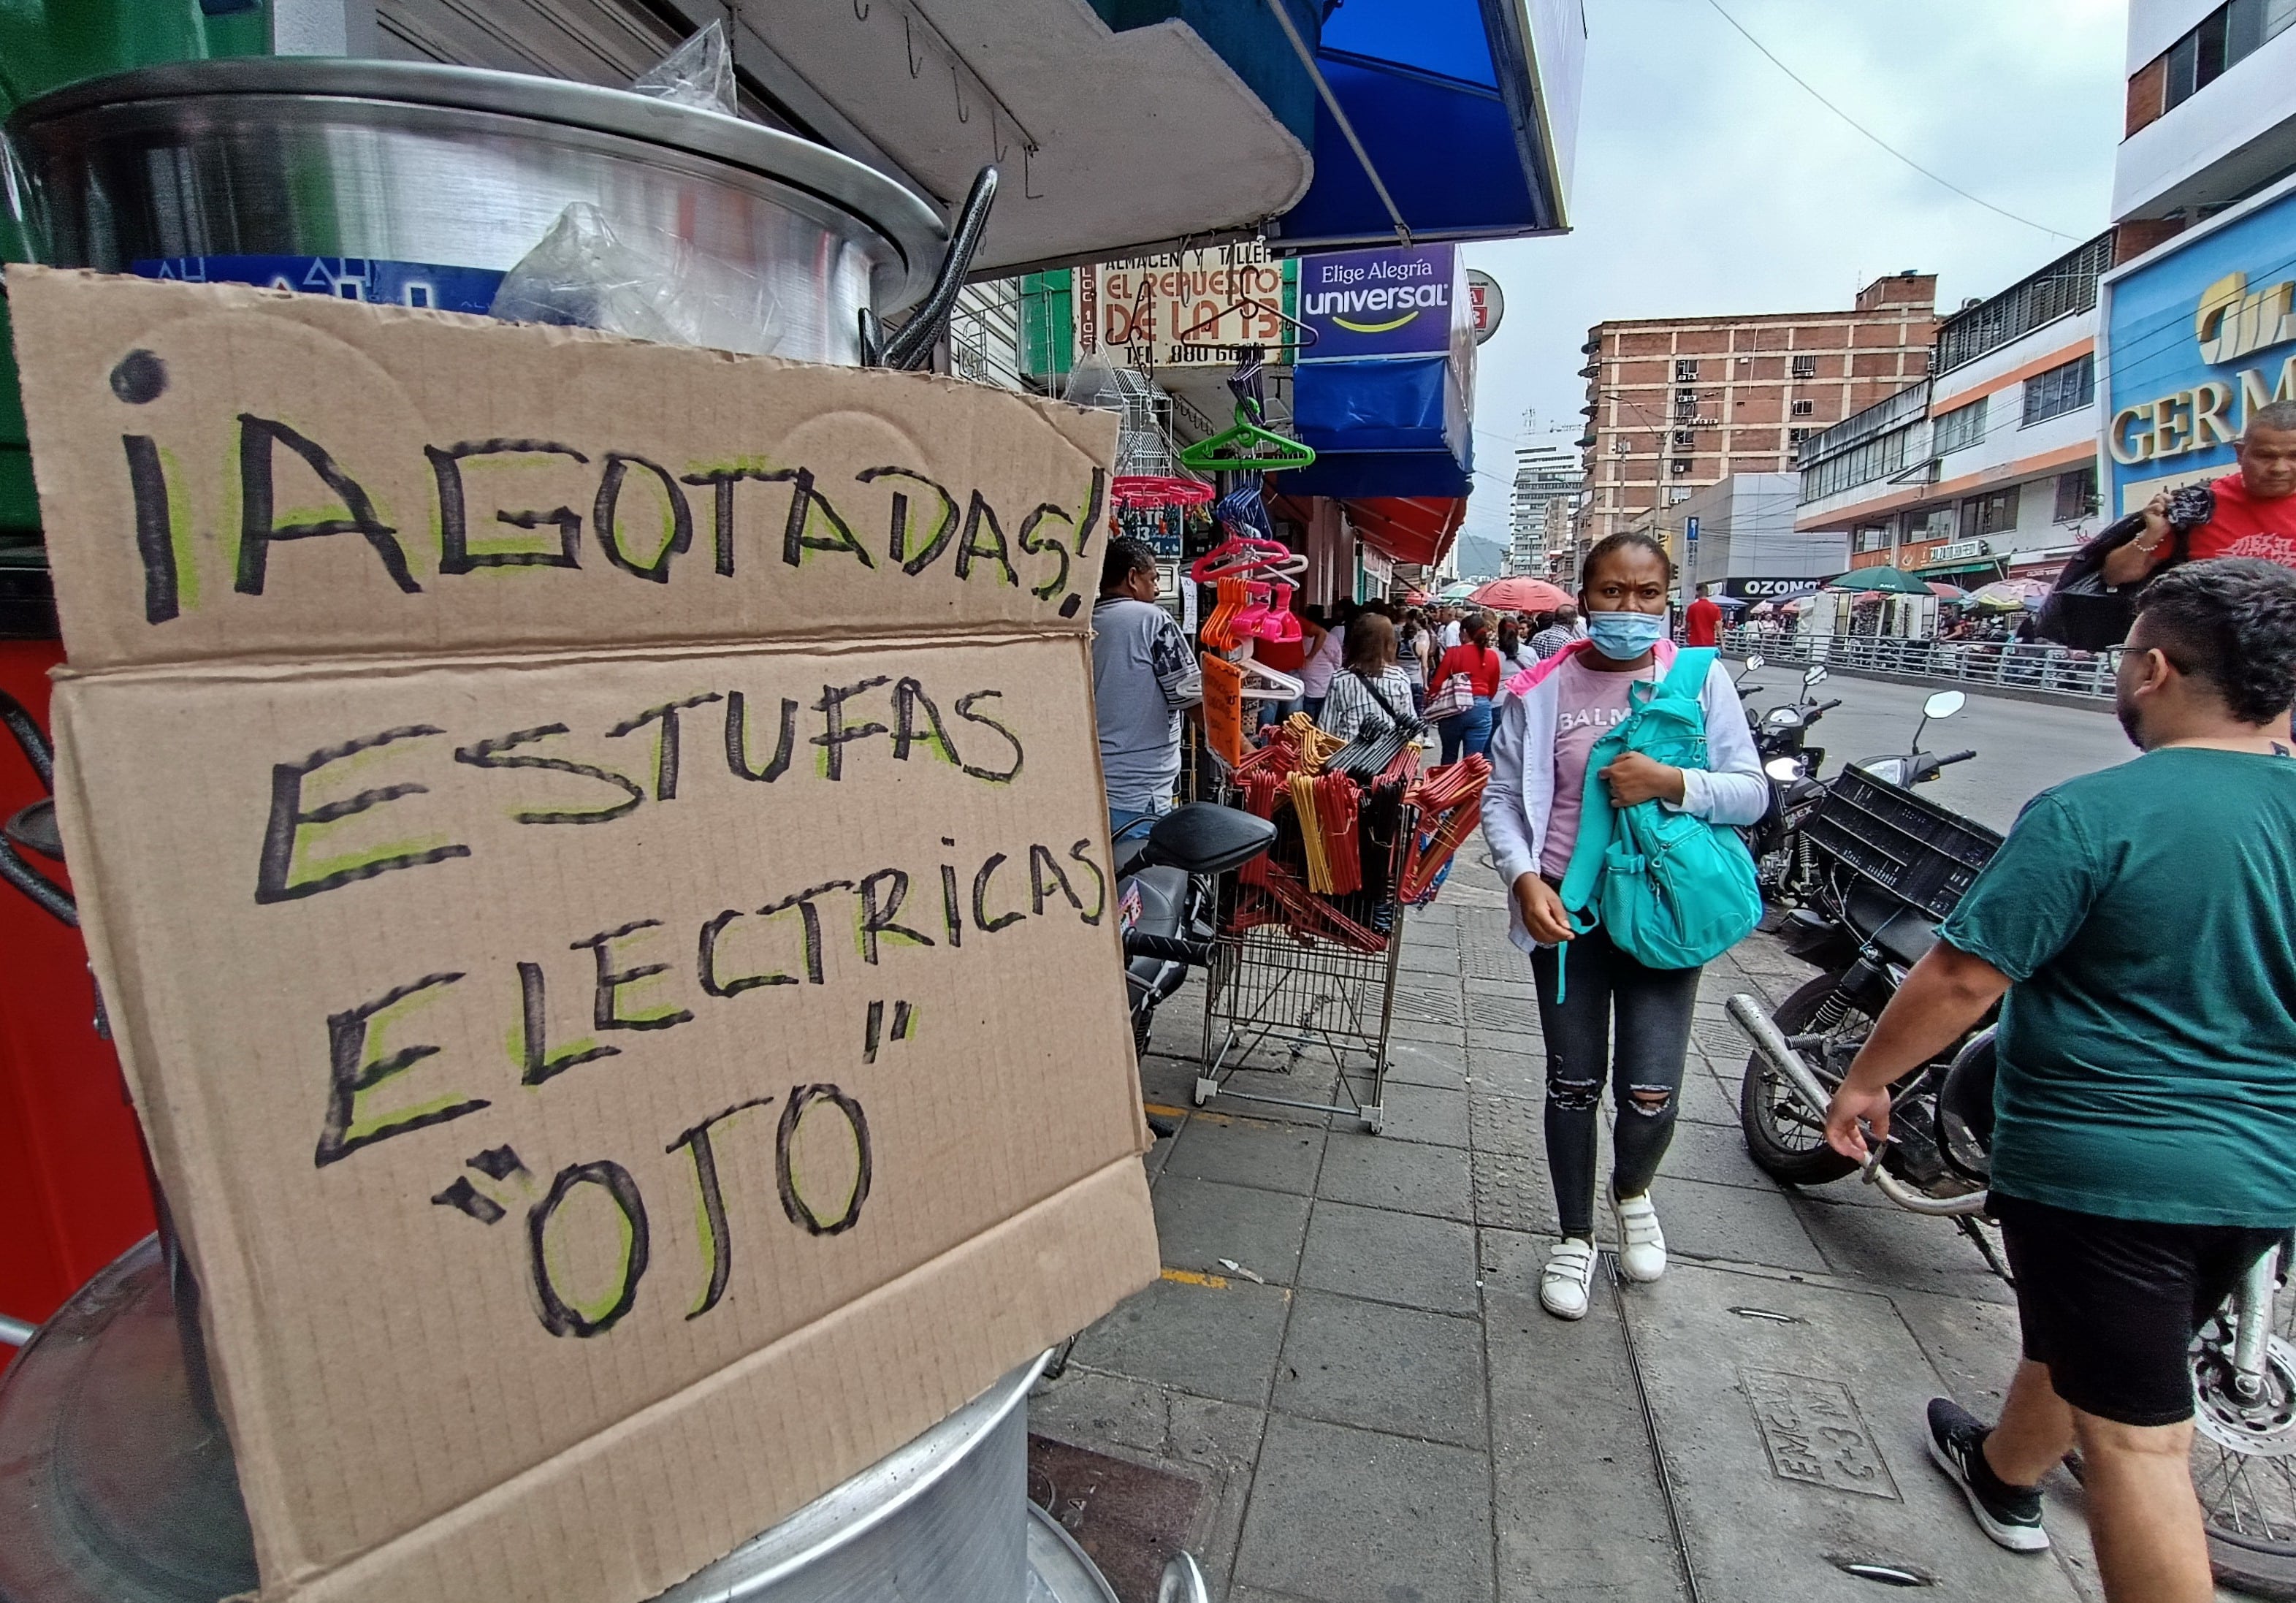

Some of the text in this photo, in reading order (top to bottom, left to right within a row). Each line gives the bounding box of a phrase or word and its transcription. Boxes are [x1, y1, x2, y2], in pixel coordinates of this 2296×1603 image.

[1322, 259, 1433, 284] Elige Alegría
[1107, 274, 1132, 300] EL
[1305, 283, 1449, 314] universal
[1106, 297, 1279, 343] DE LA 13
[1171, 344, 1208, 363] 880
[255, 675, 1023, 905] ESTUFAS
